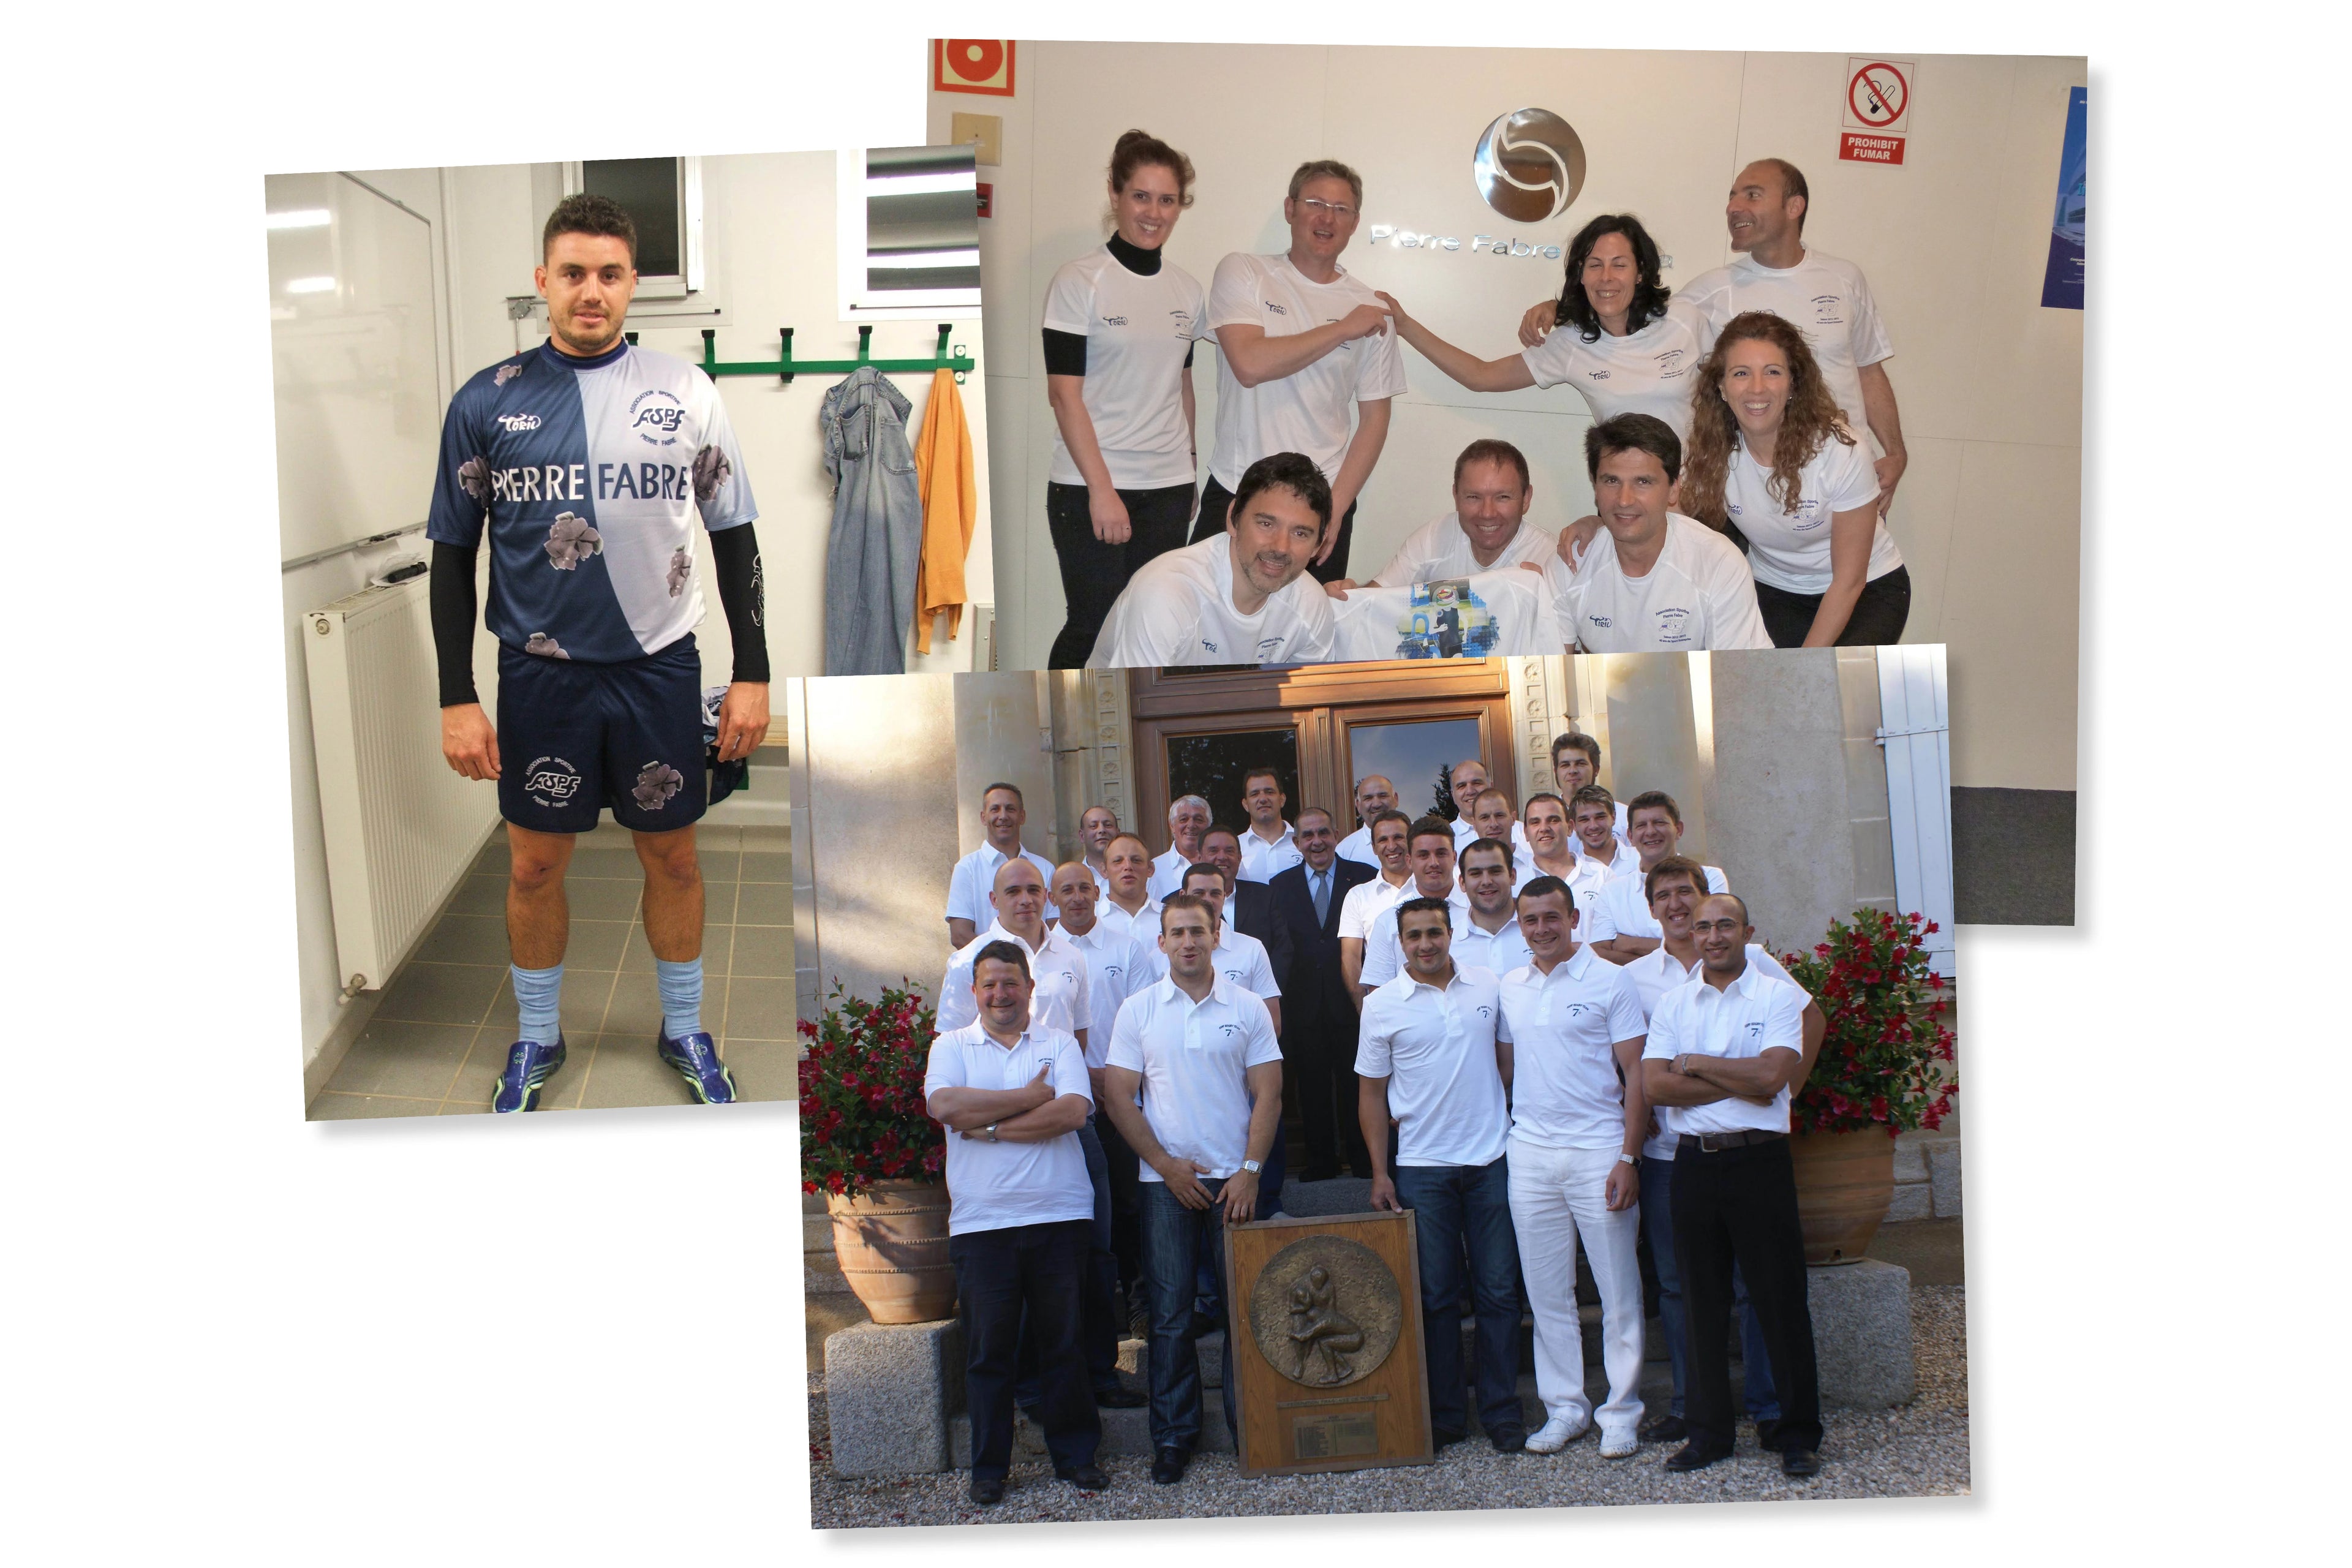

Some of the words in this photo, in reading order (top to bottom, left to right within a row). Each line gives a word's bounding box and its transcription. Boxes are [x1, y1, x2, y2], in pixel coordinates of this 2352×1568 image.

[1848, 137, 1898, 149] PROHIBIT
[1853, 148, 1890, 160] FUMAR
[1370, 225, 1460, 251] Pierre
[1472, 234, 1561, 259] Fabre
[630, 390, 654, 414] ASSOCIATION
[658, 391, 681, 405] SPORTIVE
[498, 413, 541, 432] TORIL
[640, 433, 658, 445] PIERRE
[662, 437, 676, 446] FABRE
[491, 464, 584, 502] PIERRE
[598, 462, 687, 500] FABRE
[526, 756, 551, 776] ASSOCIATION
[554, 757, 576, 774] SPORTIVE
[532, 795, 549, 807] PIERRE
